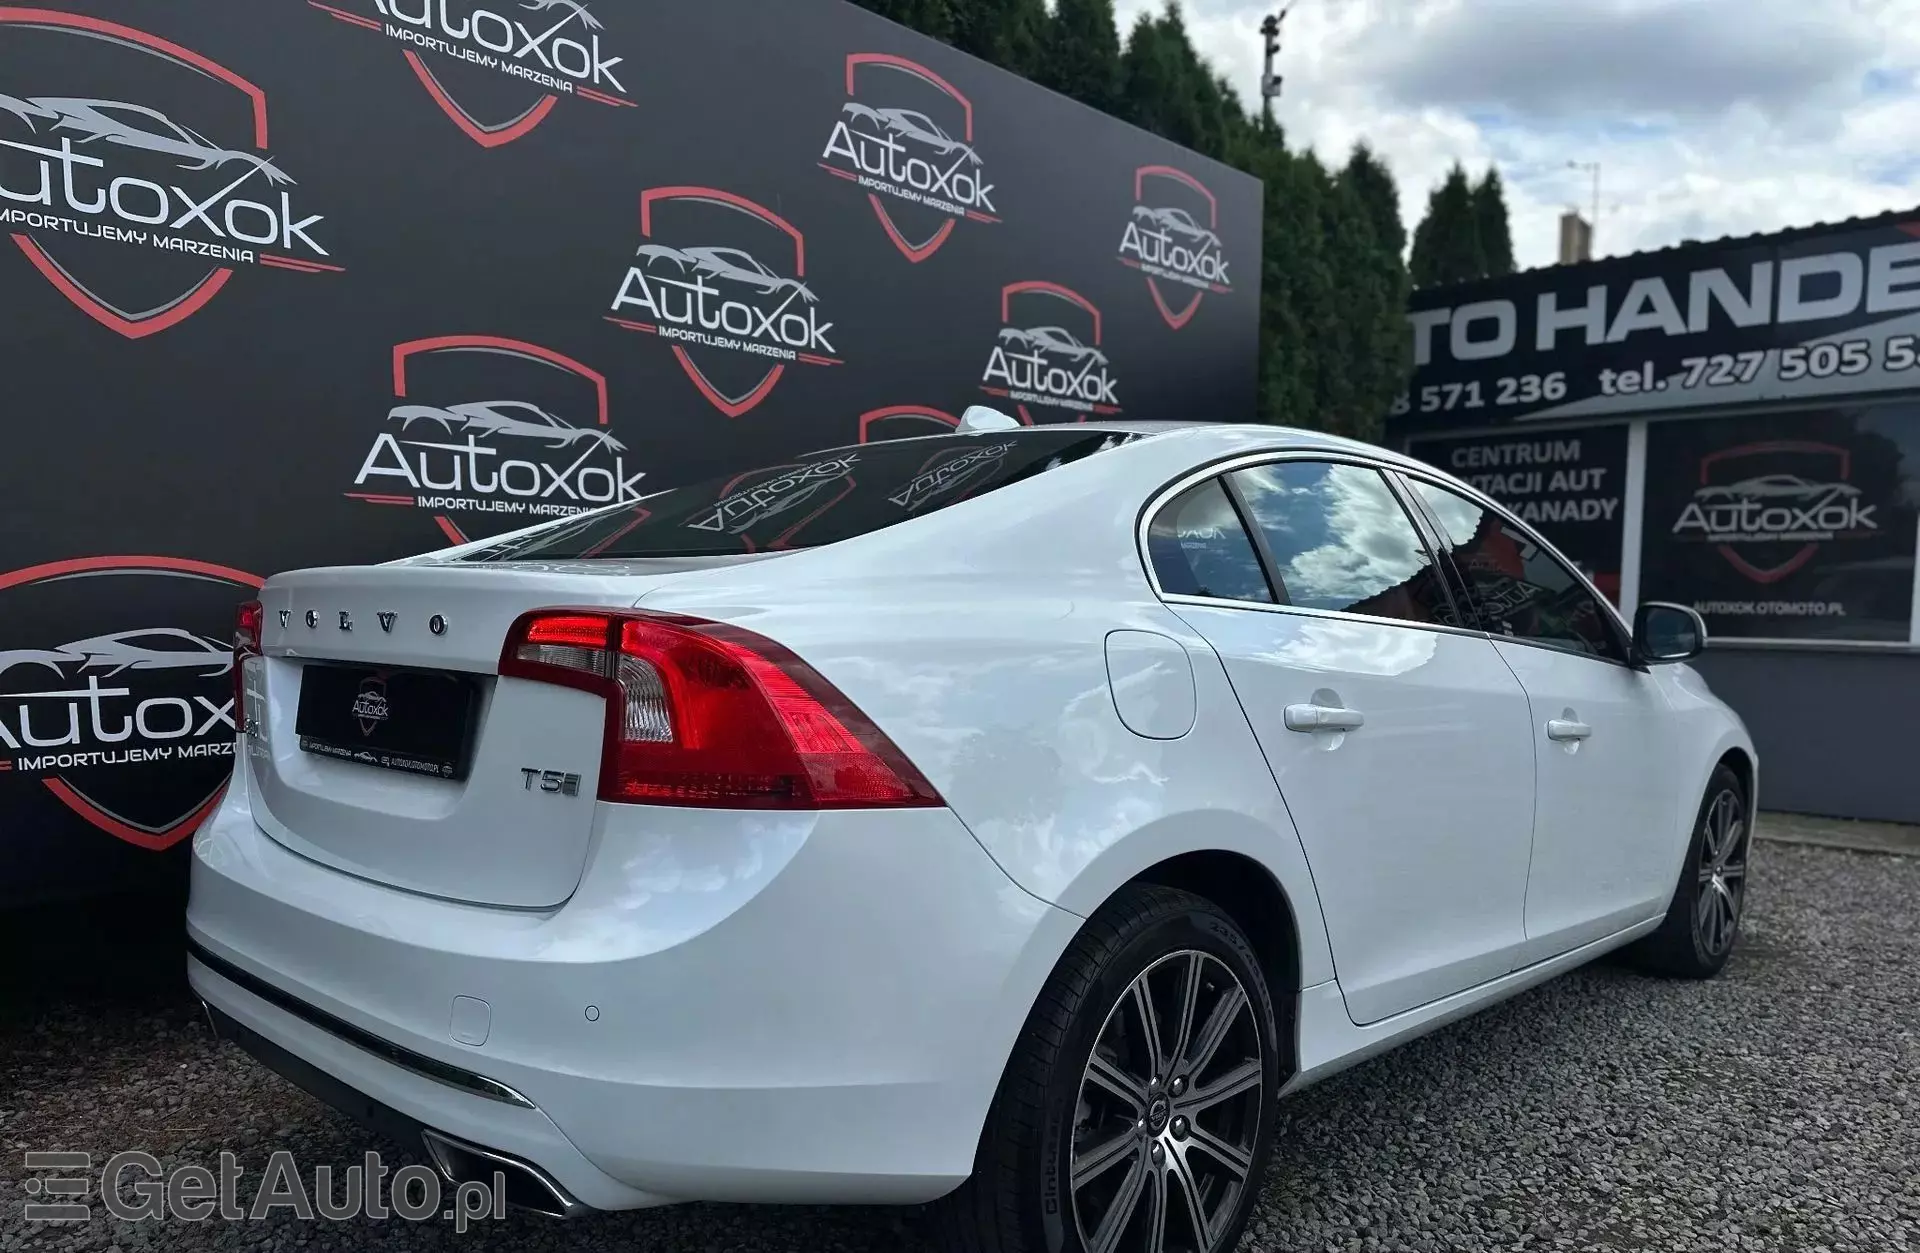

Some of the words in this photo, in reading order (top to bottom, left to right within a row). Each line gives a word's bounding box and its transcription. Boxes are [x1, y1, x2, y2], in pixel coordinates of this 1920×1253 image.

[375, 0, 627, 93] utoxok
[386, 23, 498, 69] IMPORTUJEMY
[501, 60, 573, 94] MARZENIA
[0, 136, 330, 256] utoxok
[822, 120, 996, 213] Autoxok
[858, 175, 922, 202] IMPORTUJEMY
[0, 208, 147, 245] MPORTUJEMY
[153, 233, 255, 264] MARZENIA
[1118, 221, 1230, 285] Autoxok
[610, 266, 836, 354] Autoxok
[1404, 299, 1517, 366] TO
[1535, 241, 1920, 352] HANDE
[659, 326, 741, 351] IMPORTUJEMY
[742, 342, 797, 361] MARZENIA
[1419, 380, 1485, 413] 571
[1495, 371, 1568, 406] 236
[1598, 360, 1668, 395] tel.
[1681, 350, 1766, 389] 727
[1778, 339, 1872, 381] 505
[1883, 334, 1920, 371] 5
[983, 345, 1119, 404] Autoxok
[354, 429, 647, 502] Autoxok
[1451, 439, 1581, 468] CENTRUM
[1547, 467, 1608, 493] AUT
[418, 495, 526, 514] IMPORTUJEMY
[1671, 490, 1879, 534] Autoxok
[278, 608, 450, 636] VOLVO
[0, 675, 236, 749] utox
[18, 747, 172, 772] IMPORTUJEMY
[178, 742, 237, 760] MARZ
